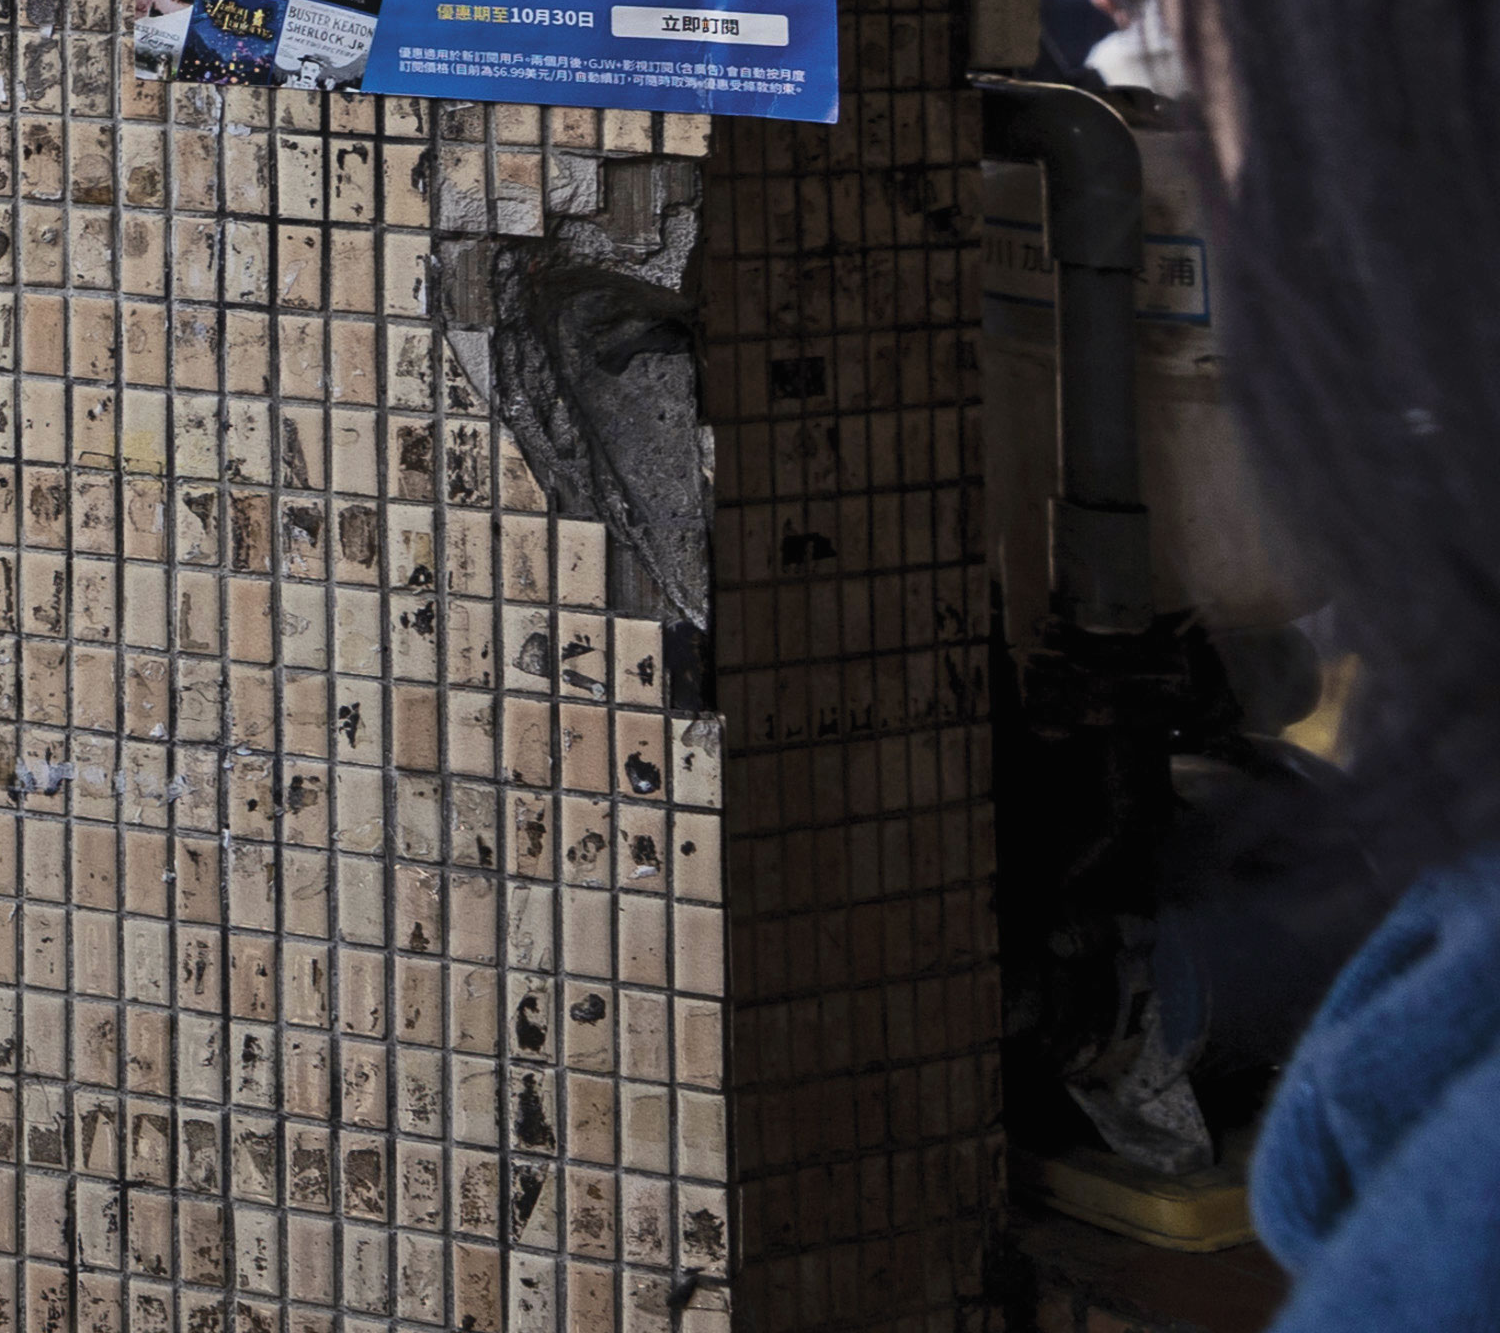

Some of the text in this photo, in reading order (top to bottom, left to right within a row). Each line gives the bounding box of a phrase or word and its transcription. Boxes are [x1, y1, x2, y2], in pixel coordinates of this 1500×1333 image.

[288, 6, 331, 27] BUSTER
[332, 18, 373, 37] KEATON
[436, 3, 594, 28] 優惠期至10月30日
[662, 15, 740, 36] 立即訂閱
